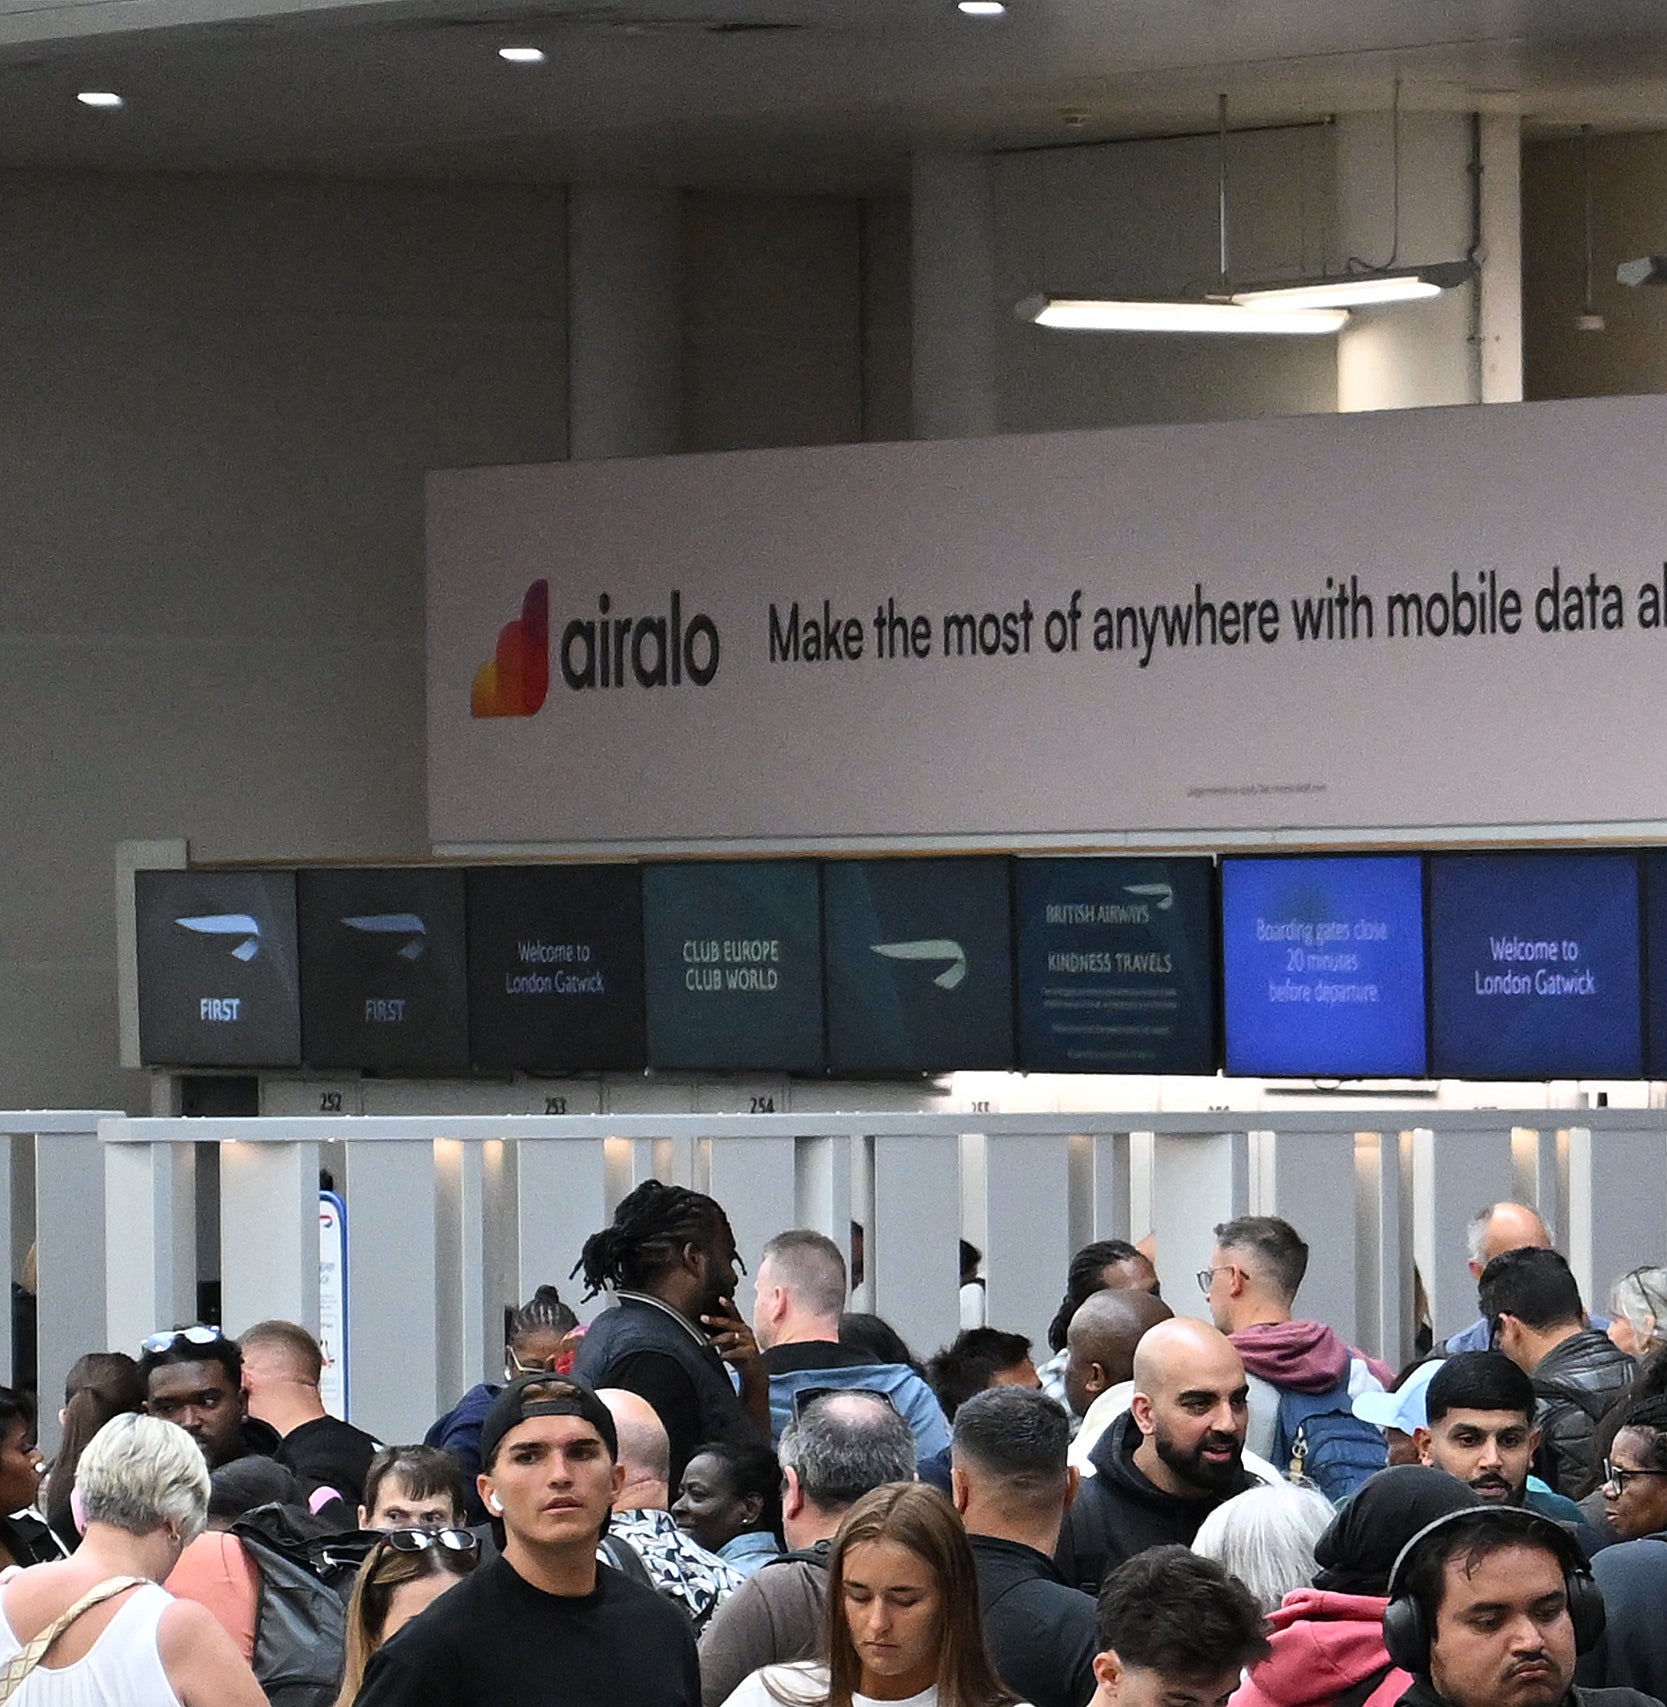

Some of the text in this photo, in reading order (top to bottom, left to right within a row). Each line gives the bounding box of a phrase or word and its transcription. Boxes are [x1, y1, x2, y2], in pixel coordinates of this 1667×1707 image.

[768, 601, 864, 666] Make
[873, 598, 934, 661] the
[942, 602, 1037, 658] most
[1044, 592, 1084, 653] of
[1092, 584, 1281, 670] anywhere
[1294, 576, 1374, 643] with
[1385, 570, 1526, 638] mobile
[1534, 567, 1627, 632] data
[560, 592, 721, 691] airalo
[1256, 919, 1313, 942] Boarding
[517, 940, 591, 963] Welcome to
[683, 941, 779, 963] CLUB EUROPE
[1286, 947, 1303, 972] 20
[1490, 936, 1578, 961] Welcome to
[1048, 953, 1172, 973] KINDNESS TRAVELS
[505, 970, 605, 995] London Gatwick
[685, 969, 778, 991] CLUB WORLD
[1268, 978, 1380, 1004] before departure
[1475, 969, 1595, 995] London Gatwick
[200, 998, 241, 1022] FIRST
[365, 998, 405, 1022] FIRST
[320, 1093, 341, 1110] 252
[749, 1097, 774, 1114] 254
